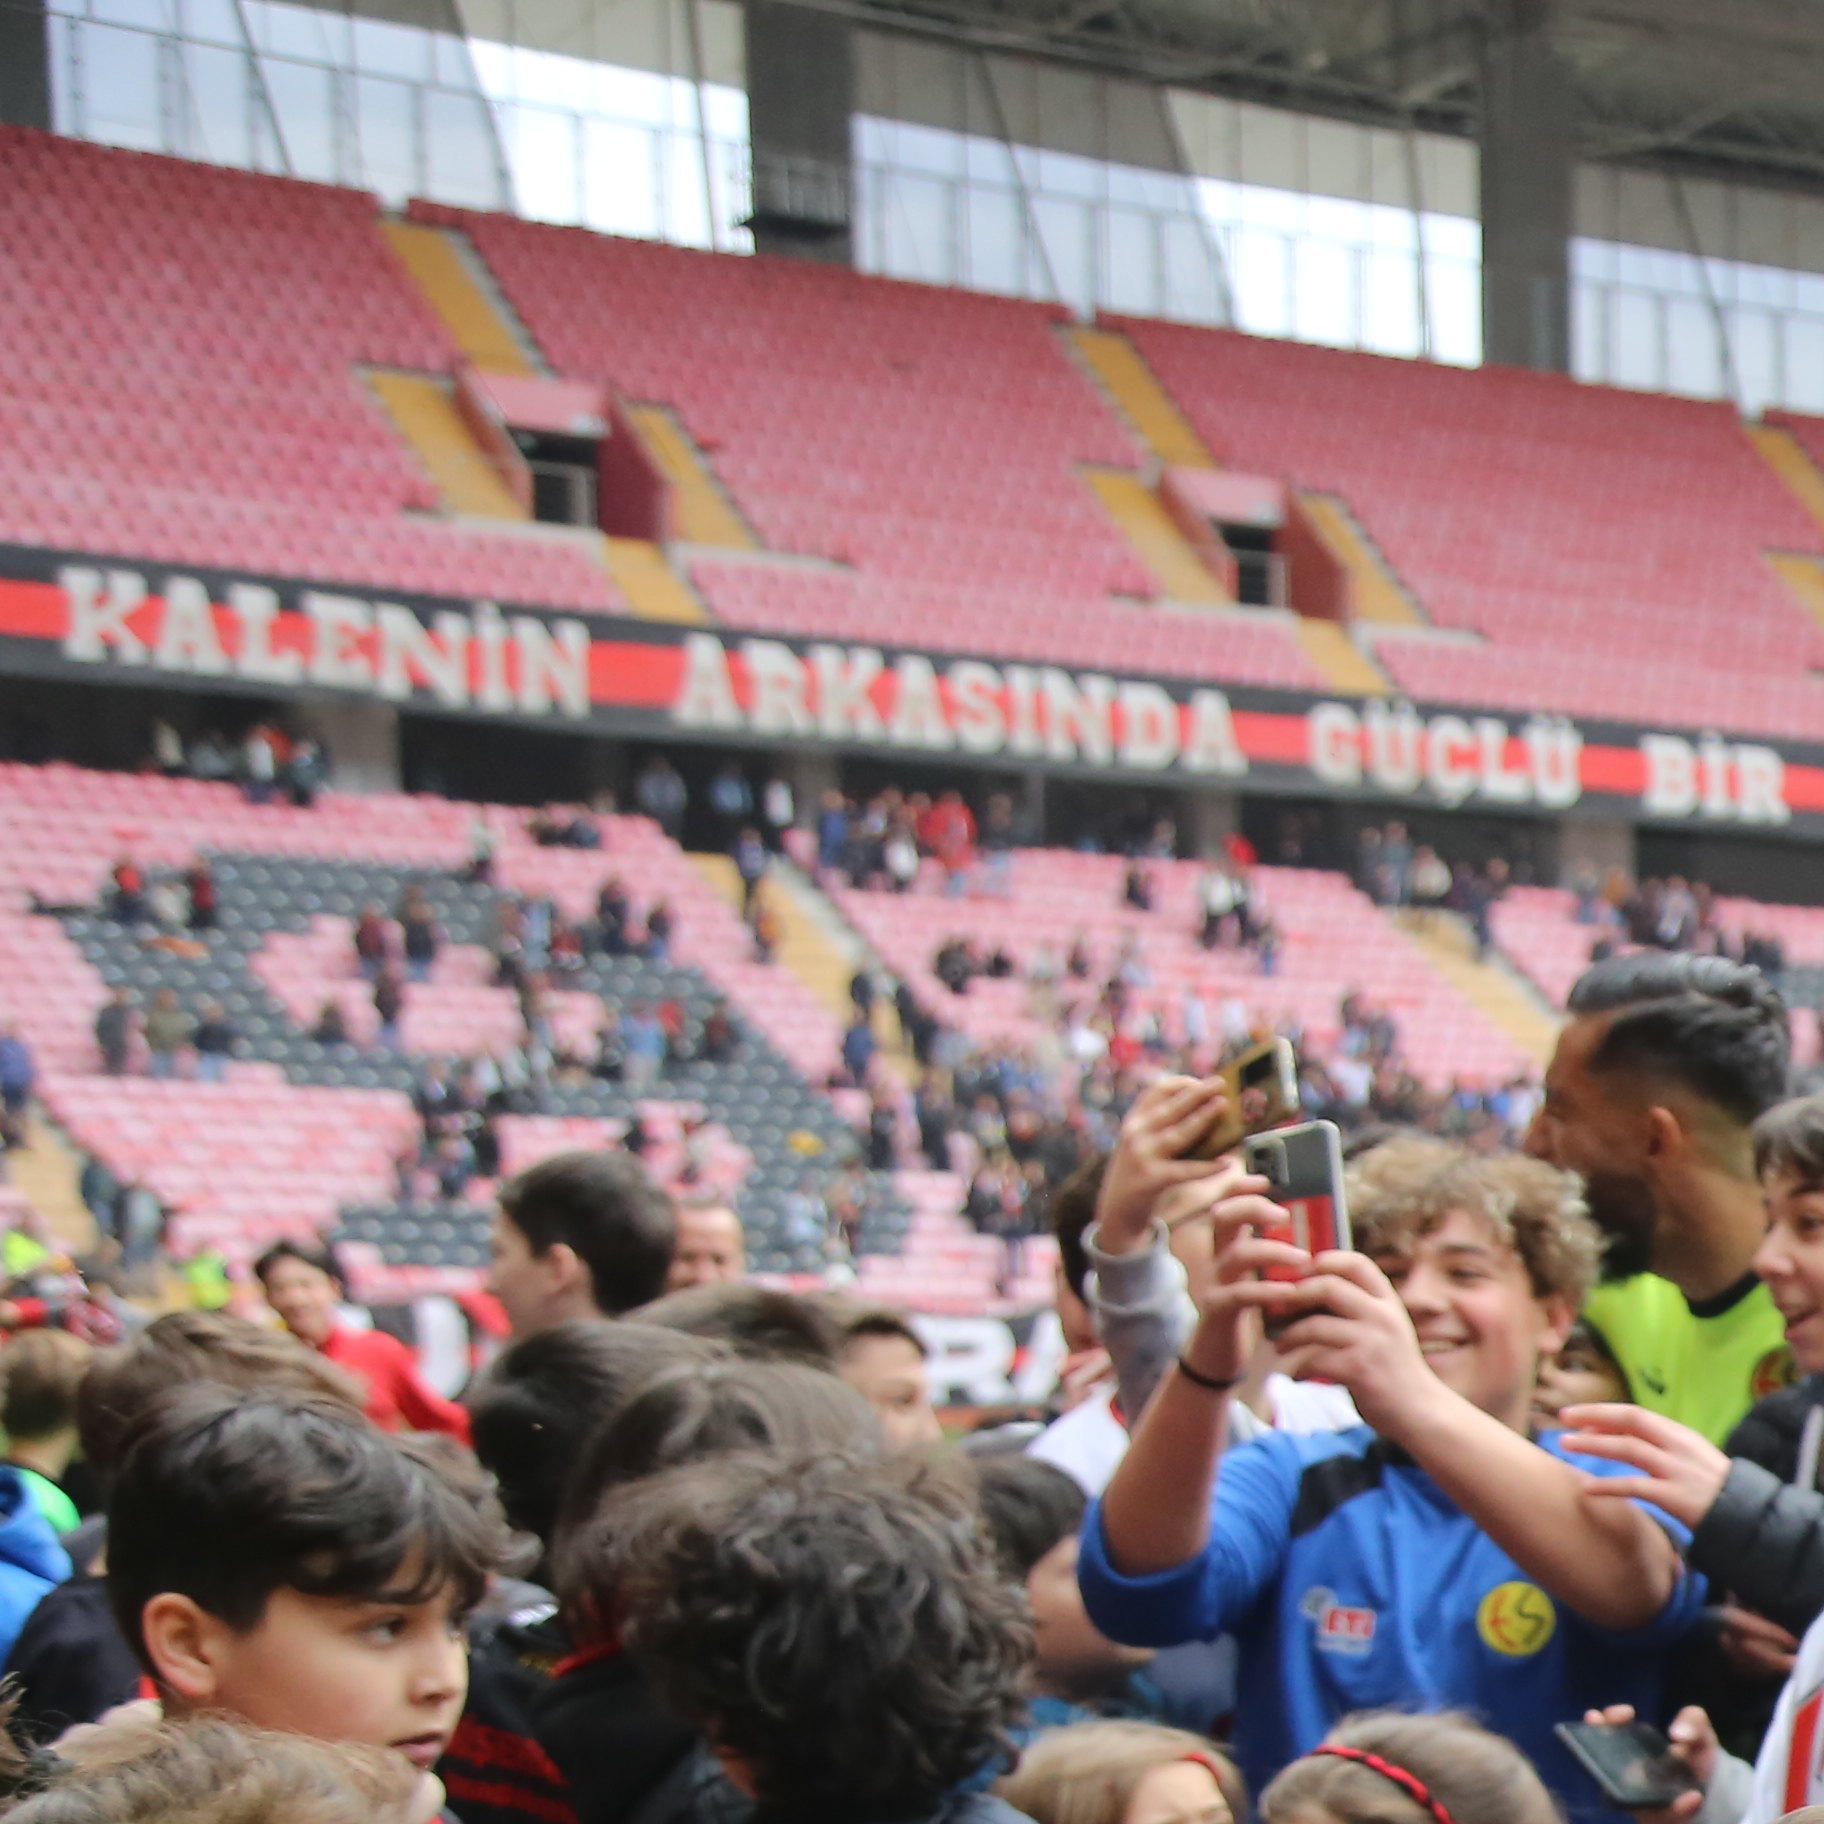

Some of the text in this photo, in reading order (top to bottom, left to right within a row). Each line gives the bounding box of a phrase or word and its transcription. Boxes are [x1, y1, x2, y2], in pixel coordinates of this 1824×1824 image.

[57, 563, 592, 718] KALENİN
[672, 631, 1250, 776] ARKASINDA
[1304, 697, 1583, 810] GÜÇLÜ
[1639, 729, 1792, 827] BİR
